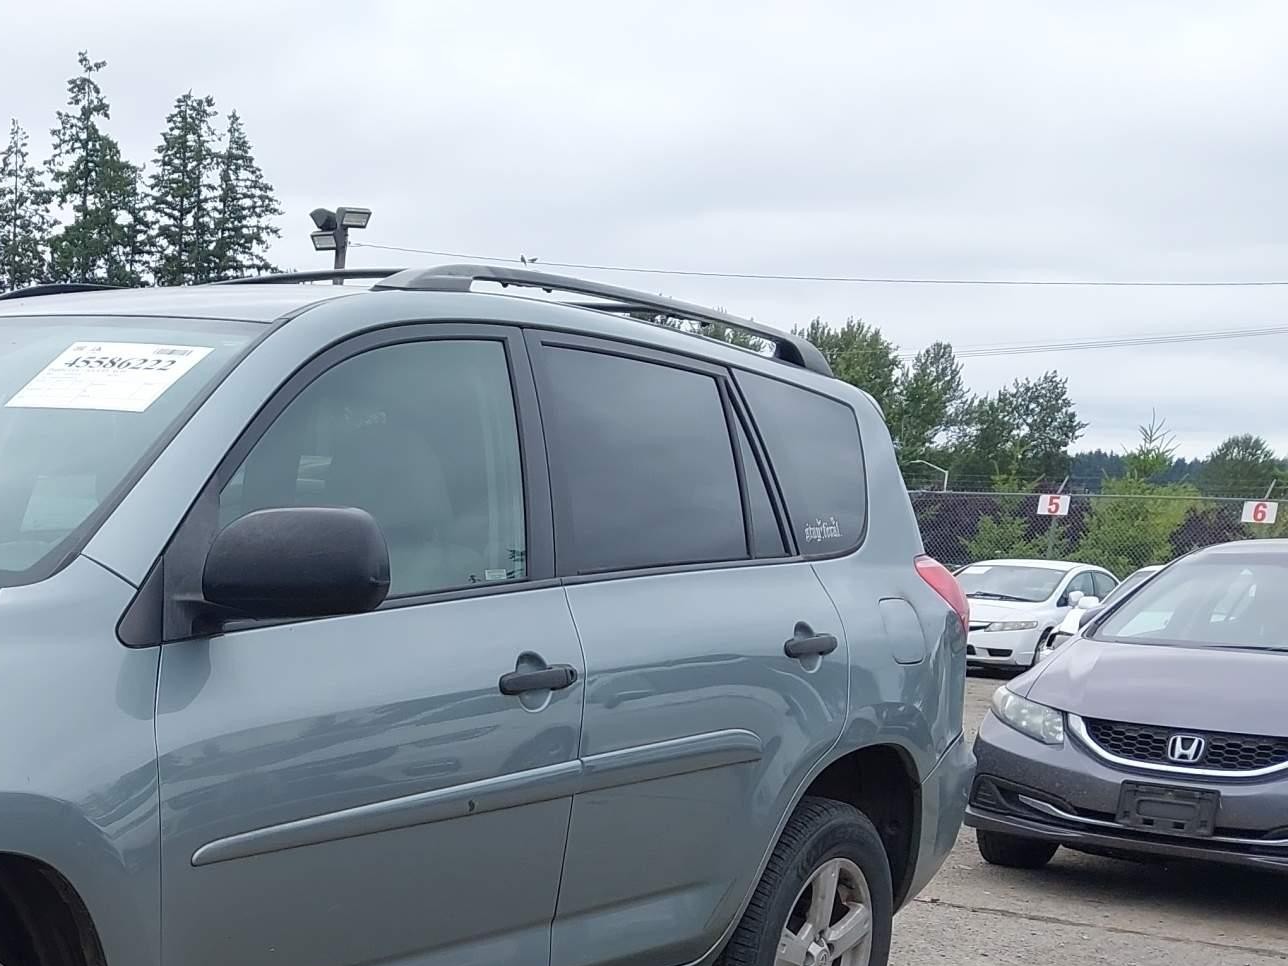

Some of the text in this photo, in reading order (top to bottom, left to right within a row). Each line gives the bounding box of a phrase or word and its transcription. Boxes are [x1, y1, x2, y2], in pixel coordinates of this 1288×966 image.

[64, 356, 177, 371] 45586222
[1046, 495, 1061, 515] 5
[1252, 502, 1268, 522] 6
